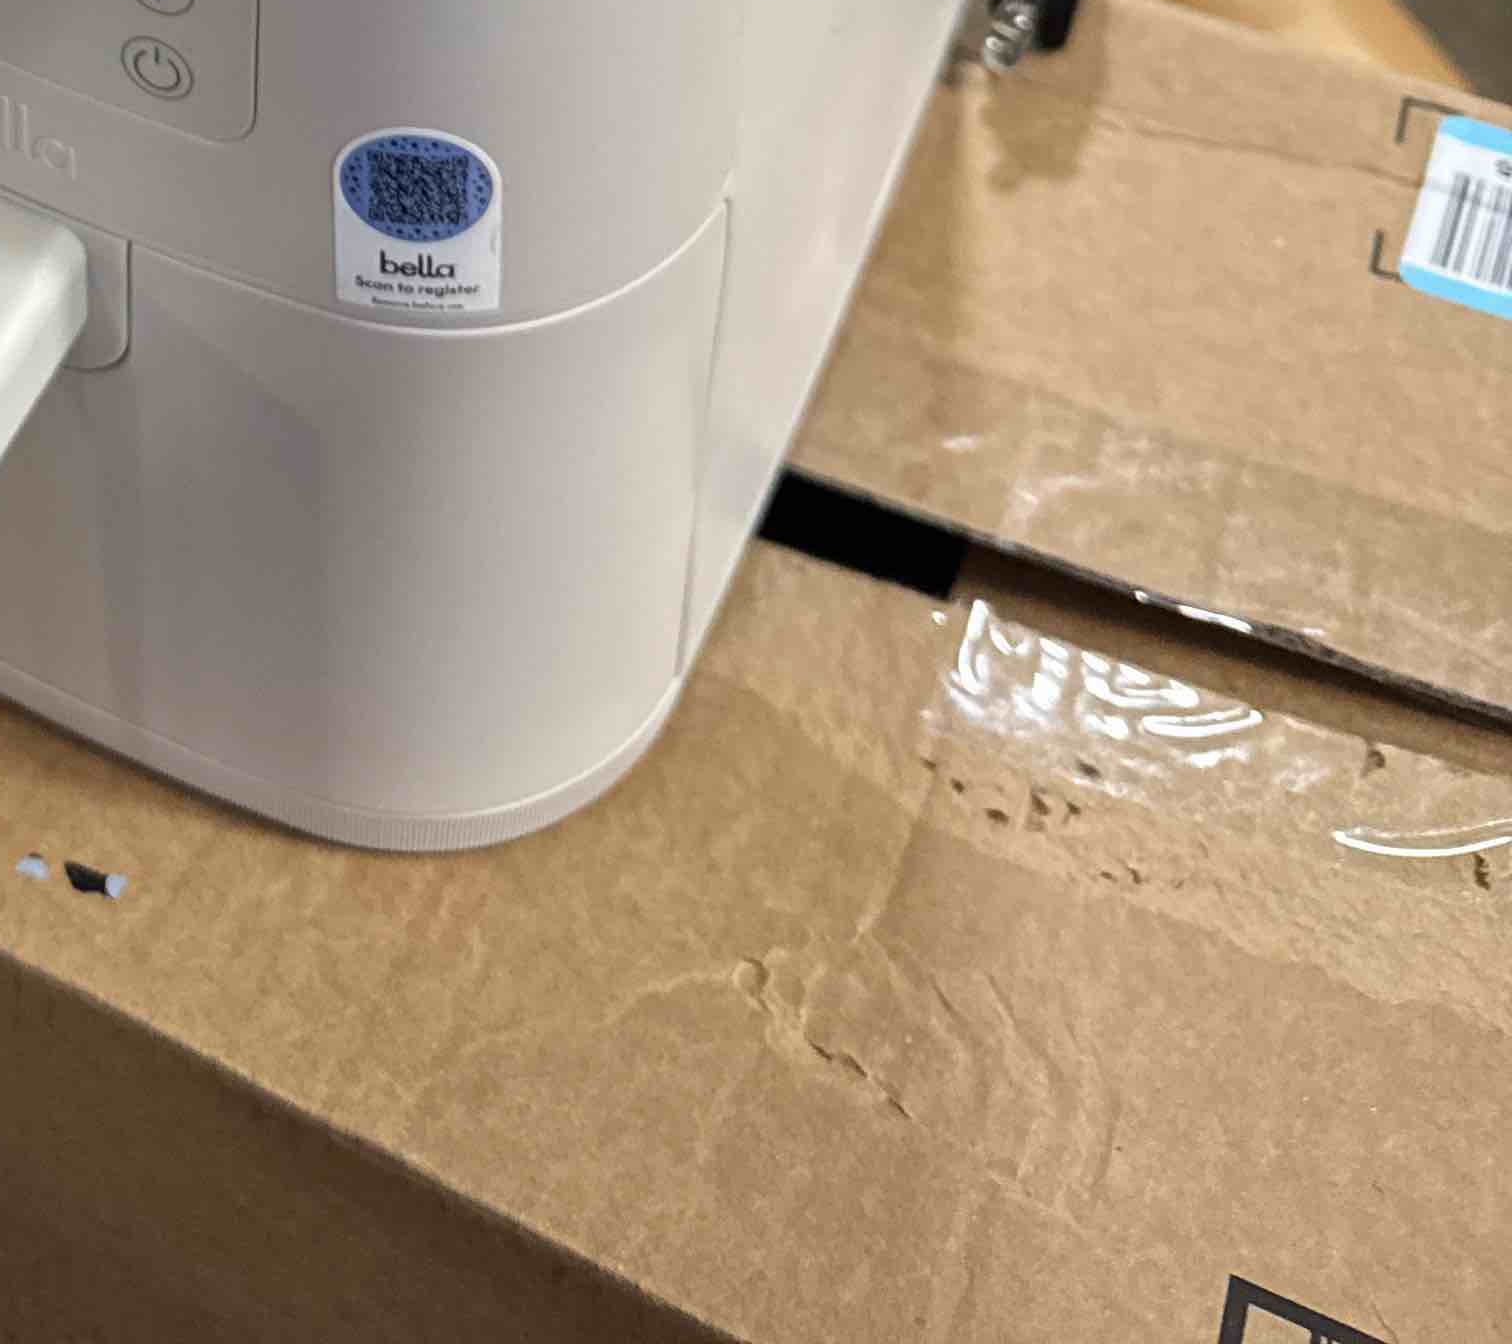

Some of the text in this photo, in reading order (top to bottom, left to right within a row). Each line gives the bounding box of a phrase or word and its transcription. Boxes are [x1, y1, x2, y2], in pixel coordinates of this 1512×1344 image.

[379, 249, 456, 279] bella
[354, 274, 481, 299] Scan to register
